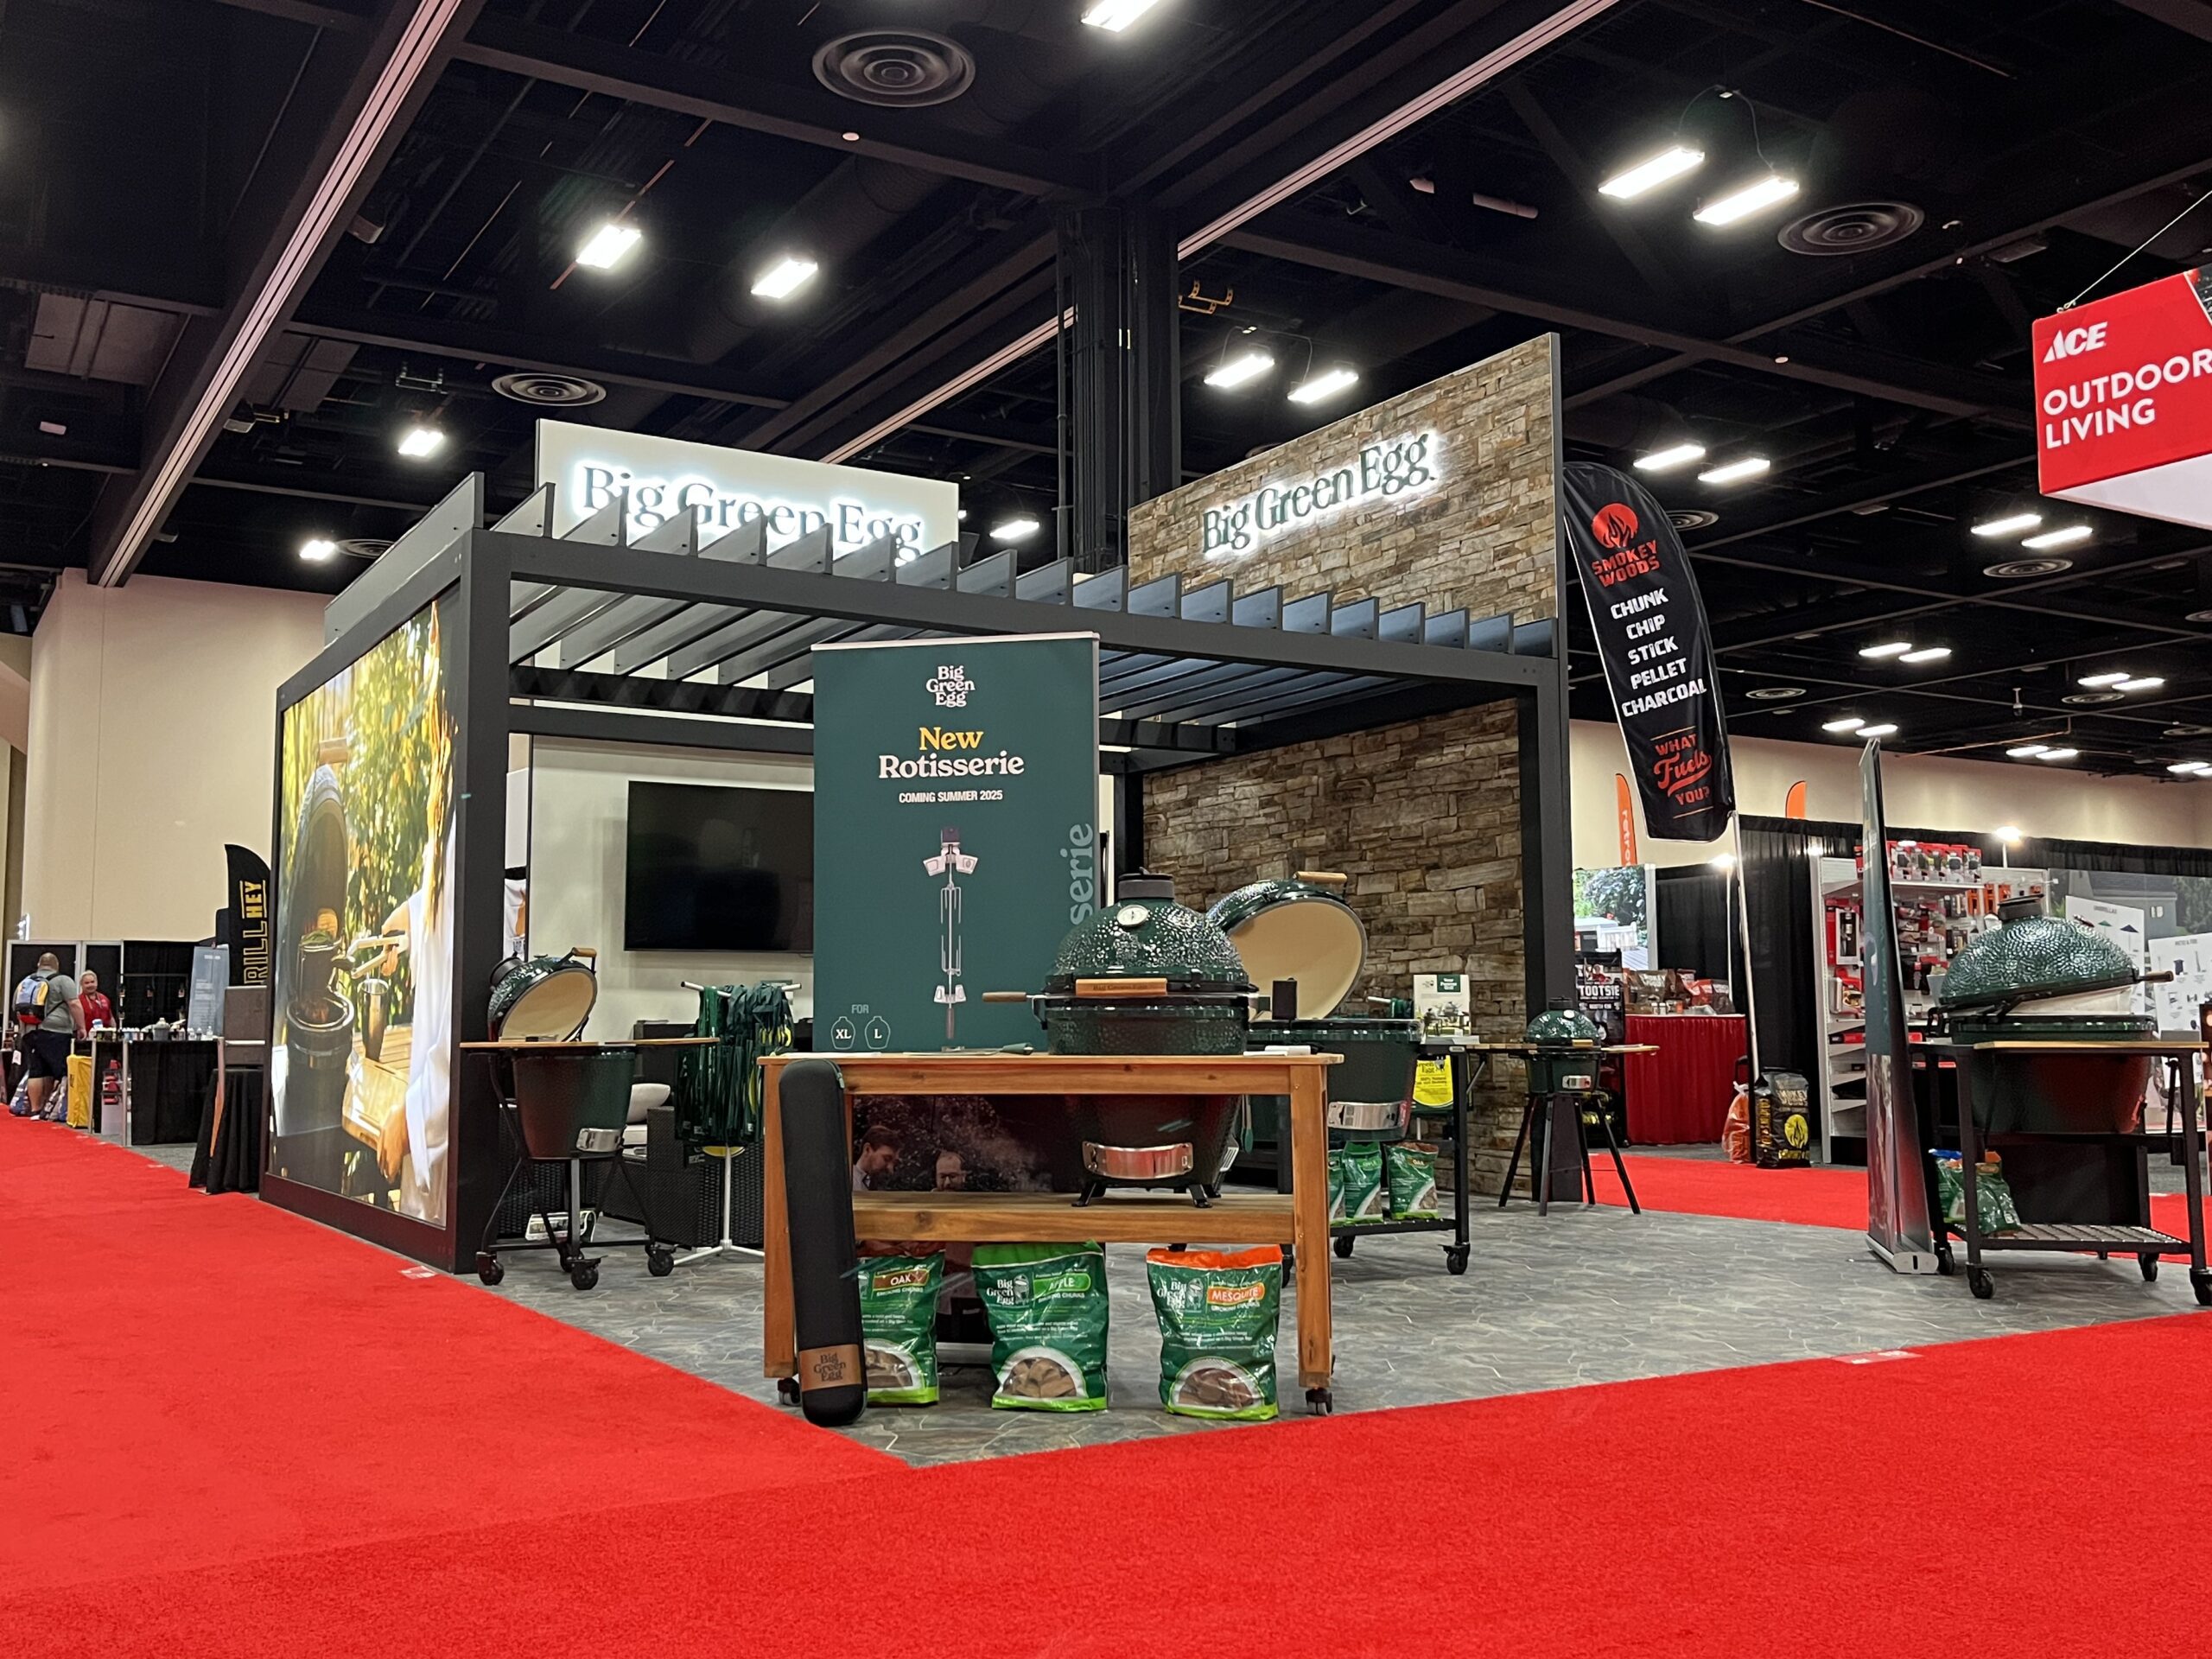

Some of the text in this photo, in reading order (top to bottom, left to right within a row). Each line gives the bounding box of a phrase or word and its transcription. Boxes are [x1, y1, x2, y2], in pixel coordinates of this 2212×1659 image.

[2043, 321, 2108, 364] ACE
[2043, 347, 2212, 416] OUTDOOR
[2044, 397, 2156, 449] LIVING
[583, 467, 666, 528] Big
[1202, 503, 1250, 553] Big
[1255, 467, 1354, 531] Green
[1592, 540, 1658, 575] SMOKEY
[1599, 556, 1660, 588] WOODS
[1610, 588, 1669, 620] CHUNK
[1626, 614, 1666, 639] CHIP
[1628, 636, 1679, 665] STICK
[938, 664, 964, 681] Big
[1630, 658, 1687, 690] PELLET
[925, 678, 976, 692] Green
[935, 691, 968, 708] Egg
[1621, 678, 1707, 717] CHARCOAL
[918, 727, 984, 751] New
[1655, 734, 1696, 755] WHAT
[878, 750, 1025, 779] Rotisserie
[1654, 749, 1712, 790] Fuels
[899, 790, 1003, 804] COMING SUMMER 2025
[1675, 785, 1710, 805] YOU?
[1059, 823, 1094, 925] serie
[243, 880, 268, 984] RILL HEY
[1580, 984, 1620, 996] TOOTSIE
[851, 1004, 869, 1014] FOR
[835, 1028, 882, 1039] XL L
[890, 1273, 912, 1286] OAK
[986, 1287, 1014, 1296] Green
[996, 1279, 1013, 1289] Big
[1211, 1286, 1259, 1302] MESQUITE
[814, 1362, 846, 1374] Green
[820, 1351, 839, 1364] Big
[821, 1370, 843, 1382] Egg
